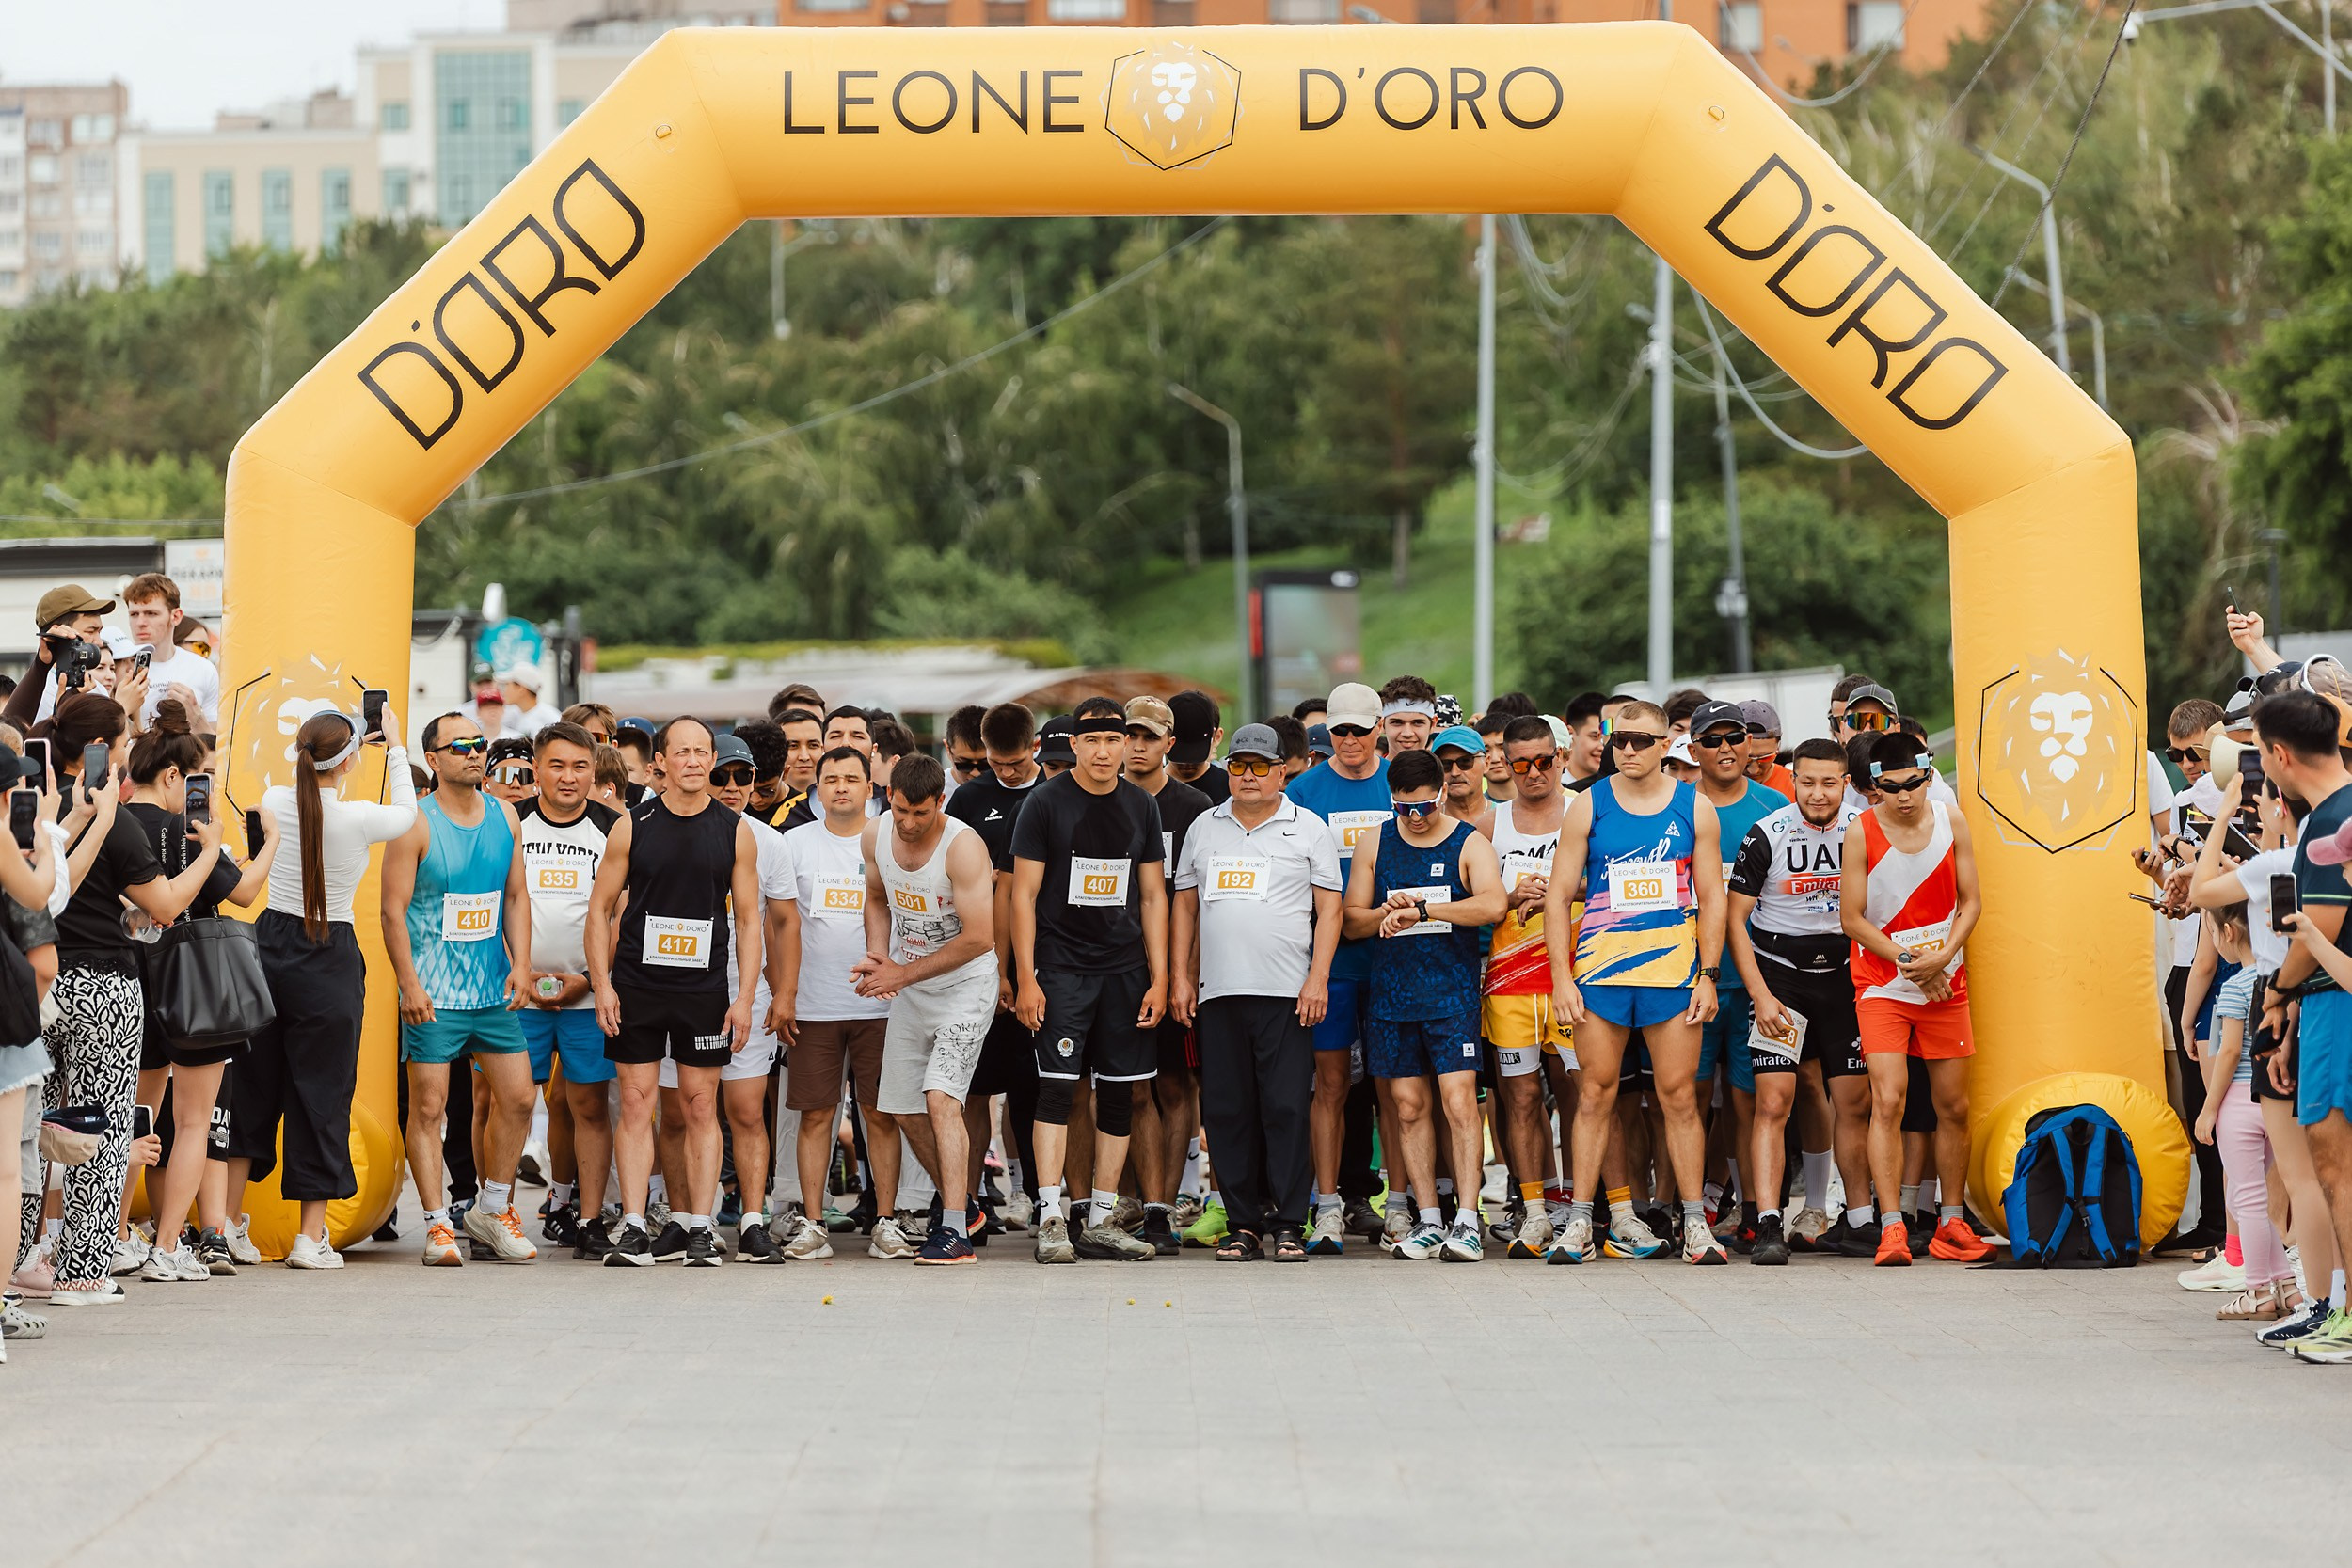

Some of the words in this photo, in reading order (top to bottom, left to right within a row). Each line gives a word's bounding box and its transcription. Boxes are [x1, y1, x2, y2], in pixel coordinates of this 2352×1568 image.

[783, 69, 1085, 135] LEONE
[1297, 65, 1564, 132] D'ORO
[318, 759, 337, 770] DIOR
[1334, 816, 1358, 824] LEONE
[1076, 863, 1100, 871] LEONE
[1510, 860, 1533, 869] LEONE
[543, 871, 577, 887] 335
[1613, 869, 1638, 878] LEONE
[887, 877, 904, 889] LEONE
[1087, 877, 1116, 893] 407
[1222, 873, 1252, 888] 192
[1628, 880, 1659, 897] 360
[449, 898, 473, 907] LEONE
[828, 890, 860, 907] 334
[898, 893, 922, 910] 501
[460, 911, 489, 928] 410
[650, 922, 675, 931] LEONE
[660, 936, 695, 953] 417
[1898, 936, 1920, 944] LEONE
